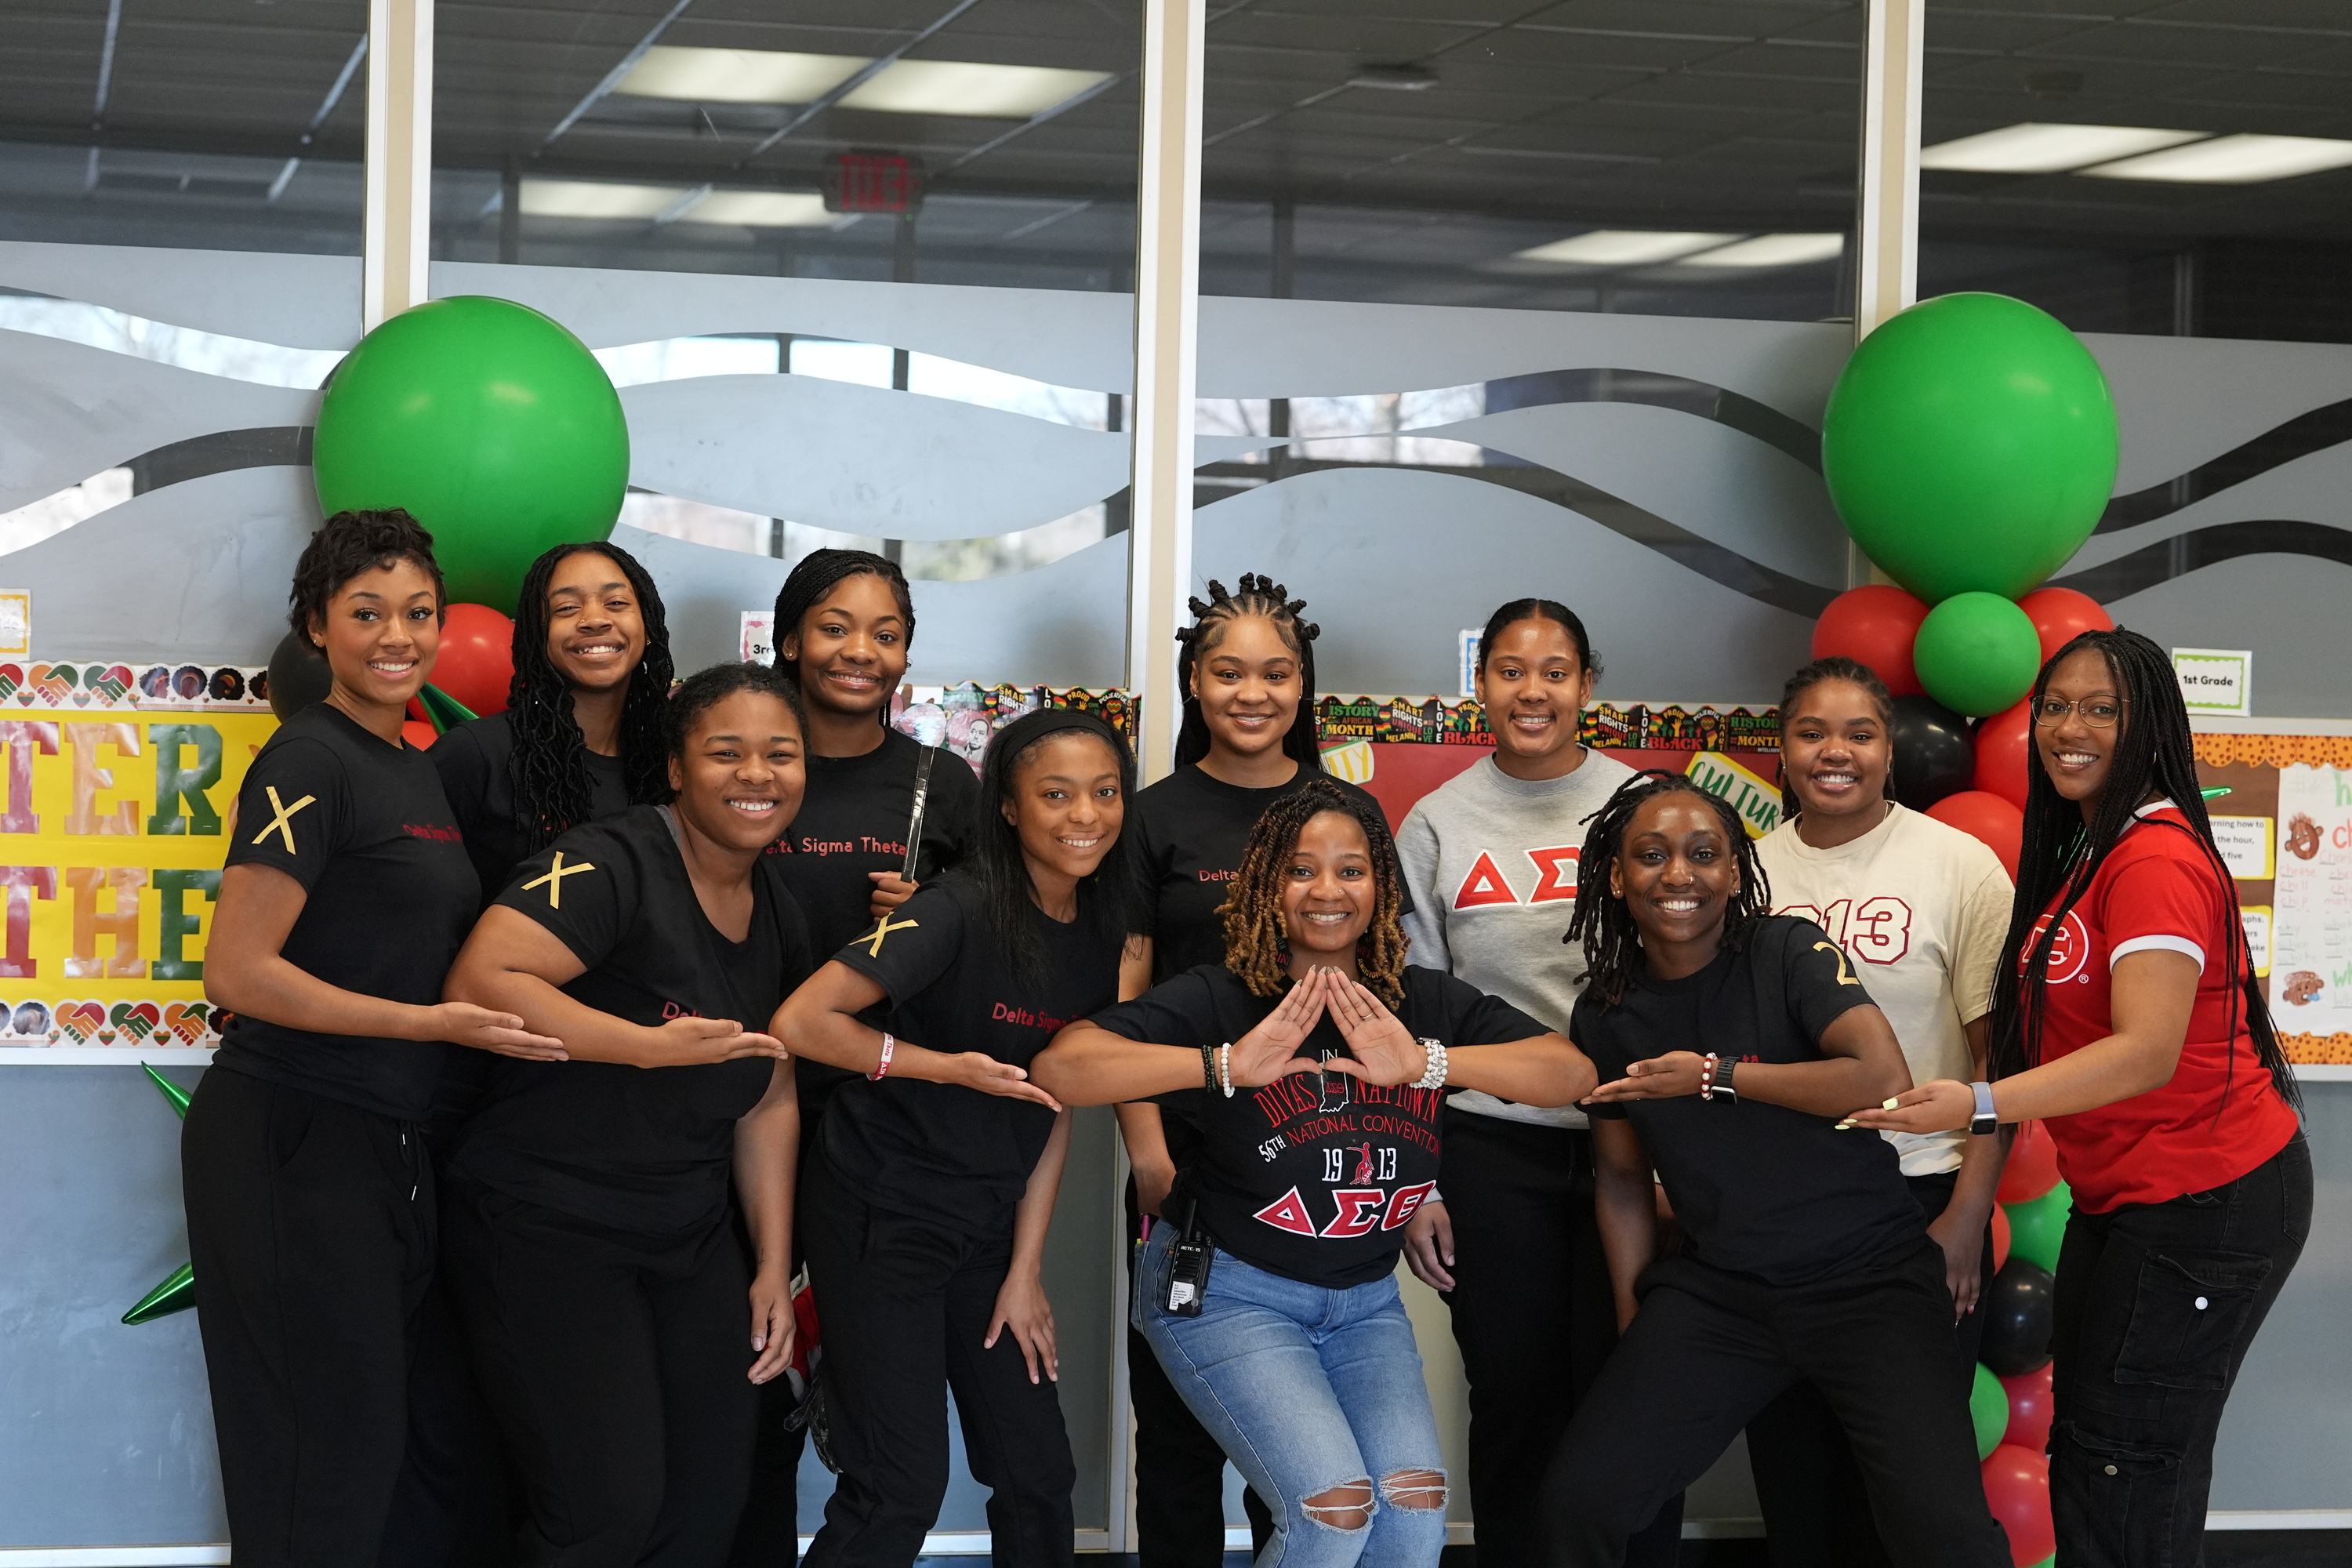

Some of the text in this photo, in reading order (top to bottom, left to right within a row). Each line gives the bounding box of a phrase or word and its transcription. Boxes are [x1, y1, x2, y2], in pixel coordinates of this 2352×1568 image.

[2183, 675, 2233, 686] 1st Grade
[999, 687, 1031, 704] SMART
[1067, 691, 1090, 702] PROUD
[999, 695, 1030, 714] RIGHTS
[1330, 706, 1380, 717] ISTORY
[1392, 700, 1424, 717] SMART
[1458, 703, 1481, 713] PROUD
[1392, 709, 1423, 728] RIGHTS
[1599, 706, 1629, 723] SMART
[1663, 709, 1685, 719] PROUD
[1327, 724, 1374, 735] MONTH
[1392, 718, 1422, 735] UNIQUE
[1599, 714, 1628, 733] RIGHTS
[1386, 731, 1417, 742] MELANIN
[1444, 731, 1497, 745] BLACK
[1599, 724, 1628, 740] UNIQUE
[1592, 737, 1621, 748] MELANIN
[1647, 737, 1704, 750] BLACK
[1689, 761, 1780, 831] CULTUR
[801, 837, 853, 856] Sigma
[860, 837, 907, 855] Theta
[2234, 836, 2255, 845] hour,
[2227, 851, 2243, 860] five
[992, 1002, 1035, 1026] Delta
[1254, 1073, 1317, 1128] DIVAS
[1258, 1114, 1441, 1163] 56TH NATIONAL CONVENTION
[1321, 1148, 1397, 1182] 19 13
